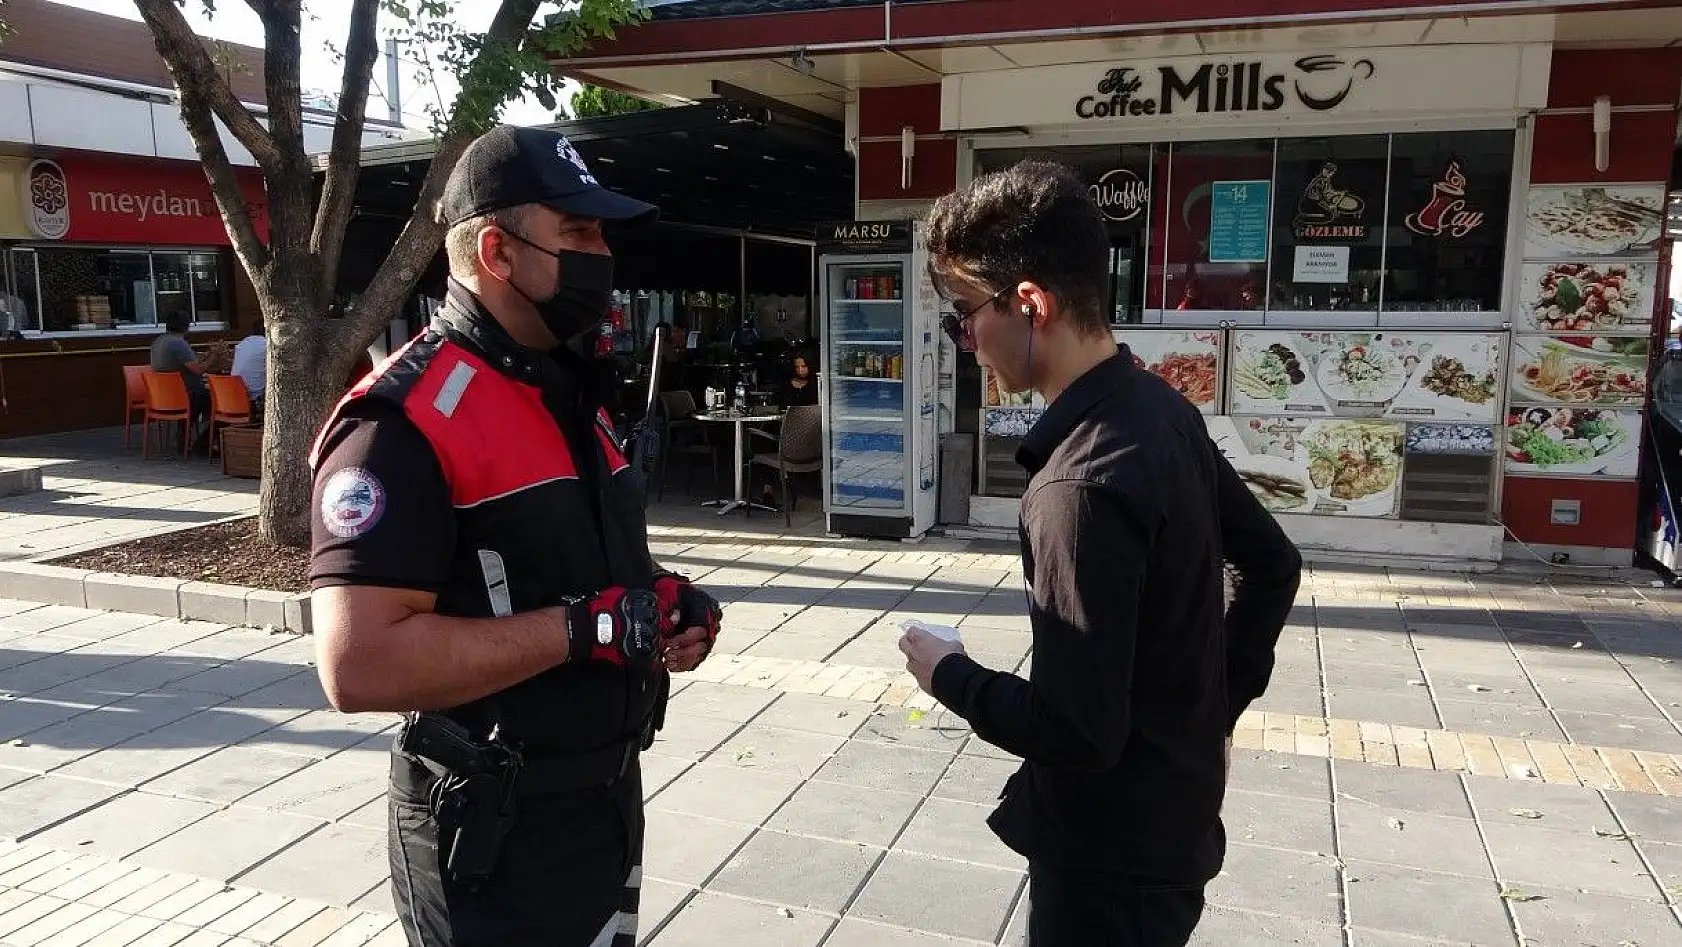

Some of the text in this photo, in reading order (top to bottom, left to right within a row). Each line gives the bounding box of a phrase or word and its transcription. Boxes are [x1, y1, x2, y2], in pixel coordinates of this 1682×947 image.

[1075, 62, 1285, 119] Coffee Mills
[88, 188, 202, 222] meydan
[1089, 180, 1149, 210] Waffle
[834, 224, 892, 239] MARSU
